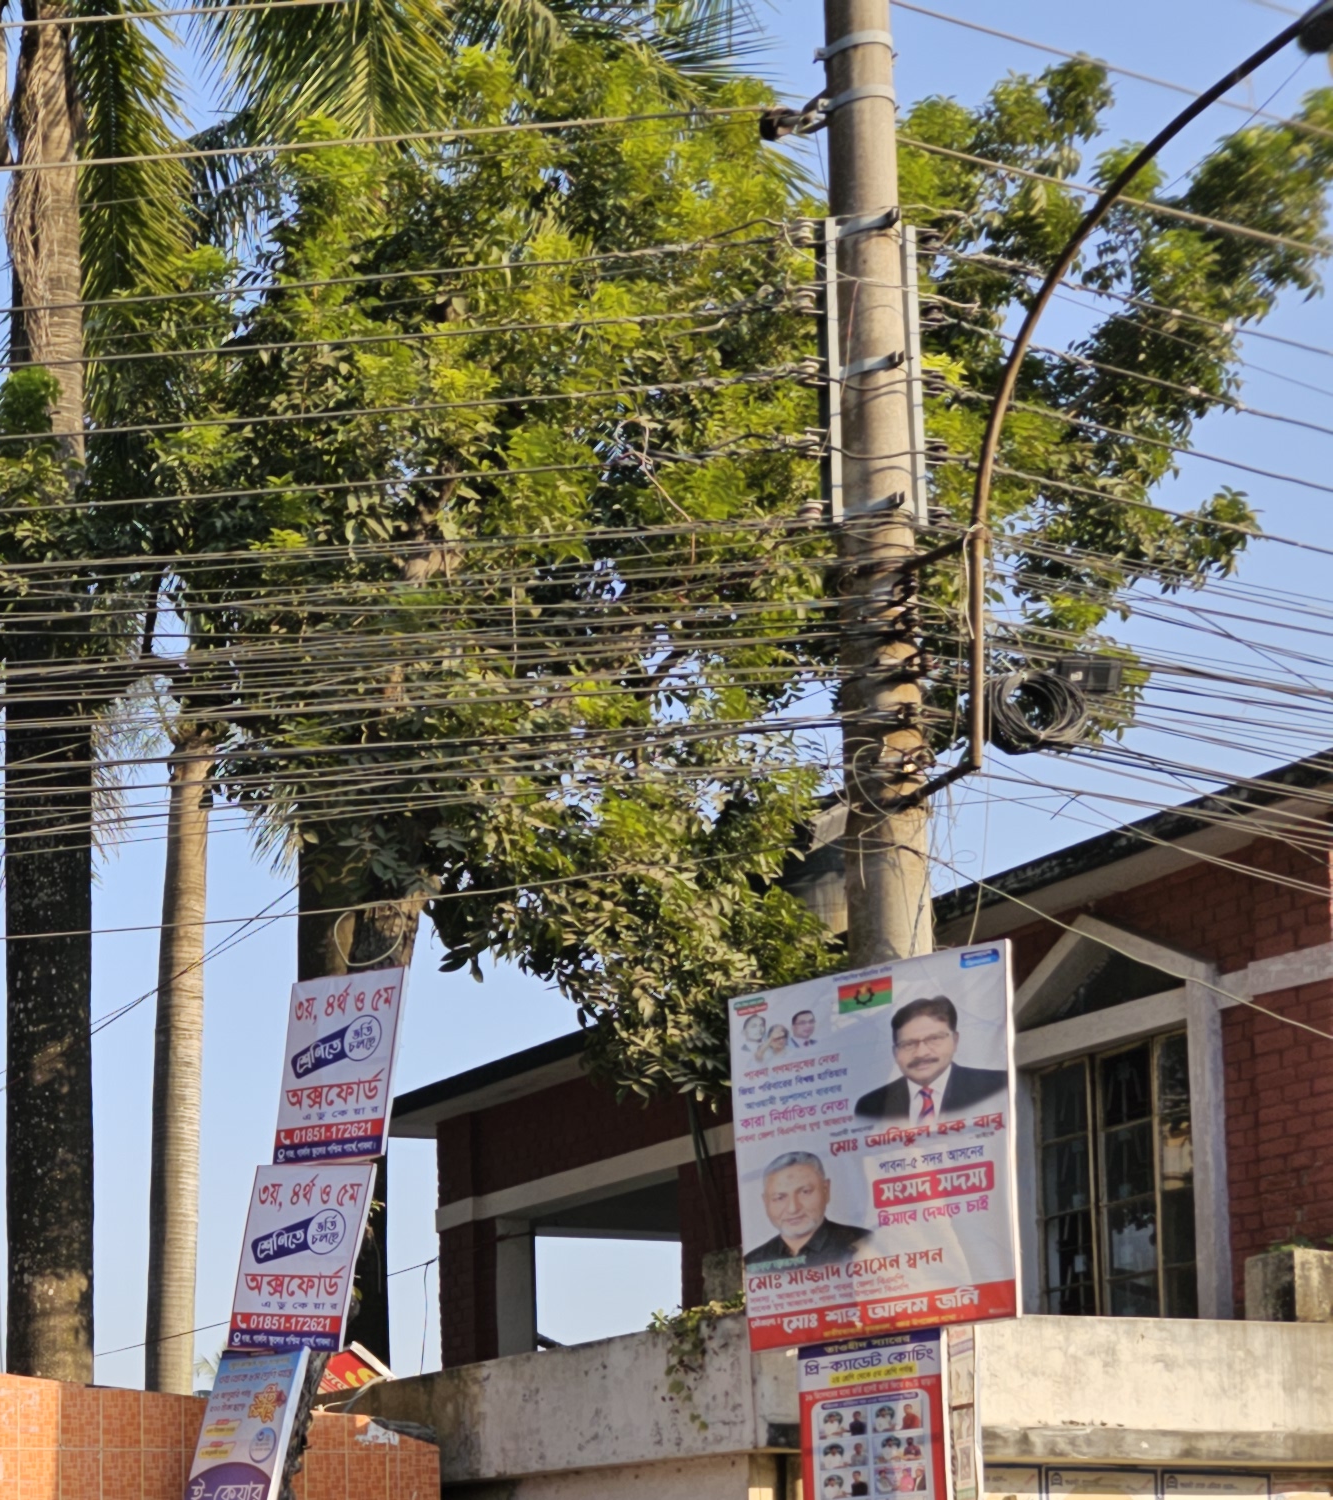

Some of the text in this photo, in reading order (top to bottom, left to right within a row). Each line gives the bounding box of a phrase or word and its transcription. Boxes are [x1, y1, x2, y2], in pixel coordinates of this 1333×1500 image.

[354, 991, 366, 1012] ও
[371, 986, 397, 1012] ৫ম
[348, 1036, 376, 1053] চলছে
[352, 1019, 373, 1040] ভর্তি
[296, 1037, 342, 1073] শ্রেণিতে
[285, 1067, 385, 1110] অক্সফোর্ড
[740, 1098, 849, 1130] কারা নির্যাতিত নেতা
[293, 1121, 372, 1143] 01851-172621
[829, 1137, 859, 1157] মোঃ
[936, 1117, 966, 1135] হক
[972, 1111, 1006, 1135] বাবু
[878, 1155, 918, 1174] পাবনা-৫
[320, 1184, 332, 1204] ও
[336, 1183, 363, 1208] ৫ম
[878, 1166, 988, 1201] সংসদ সদস্য
[315, 1214, 337, 1233] ভর্তি
[877, 1194, 990, 1228] হিসাবে দেখতে চাই
[257, 1229, 305, 1259] শ্রেণিতে
[311, 1231, 340, 1245] চলছে
[244, 1265, 347, 1299] অক্সফোর্ড
[747, 1274, 783, 1293] মোঃ
[786, 1263, 842, 1286] সাজ্জাদ
[845, 1253, 901, 1278] হোসেন
[904, 1246, 944, 1270] স্বপন
[250, 1315, 331, 1331] 01851-172621
[782, 1313, 819, 1335] মোঃ
[866, 1296, 929, 1319] আলম
[935, 1285, 980, 1310] জনি
[804, 1344, 936, 1377] প্রি-ক্যাডেট কোচিং
